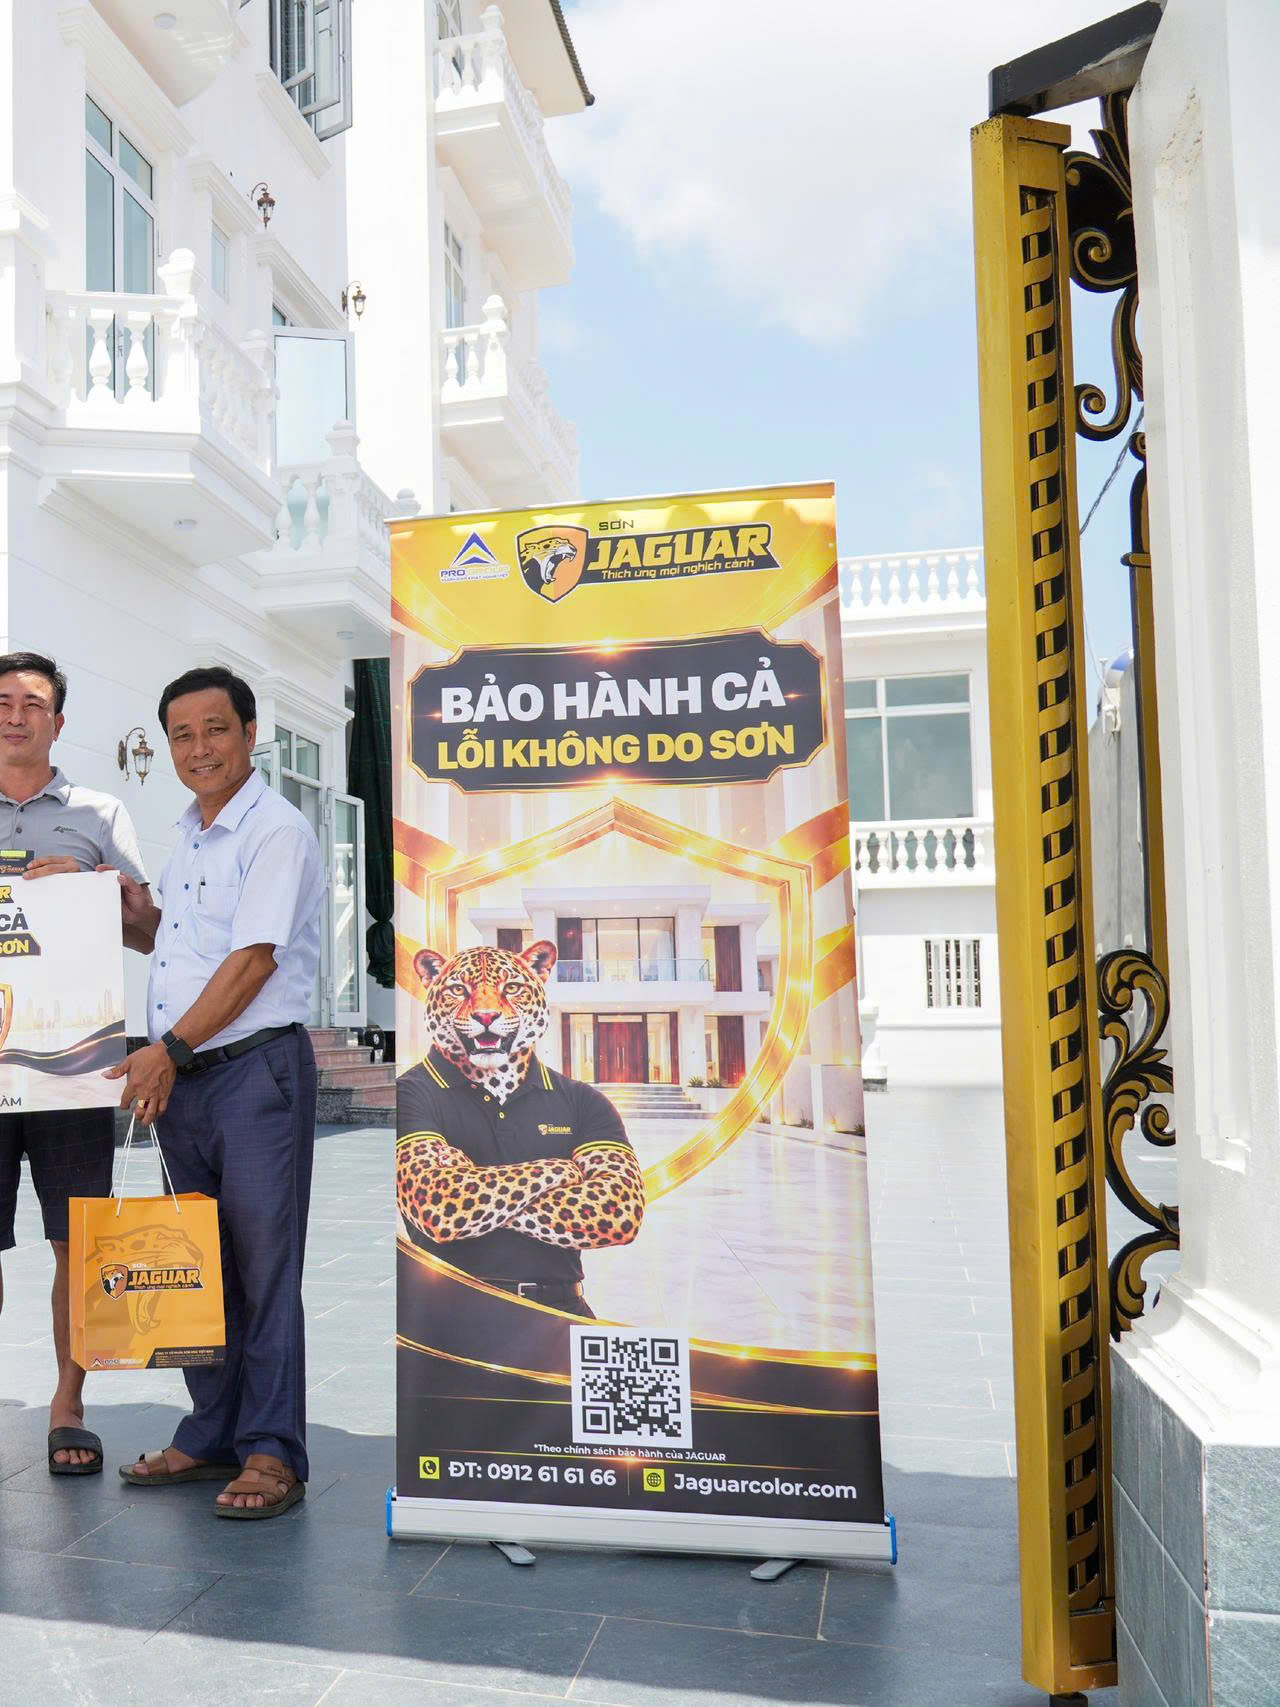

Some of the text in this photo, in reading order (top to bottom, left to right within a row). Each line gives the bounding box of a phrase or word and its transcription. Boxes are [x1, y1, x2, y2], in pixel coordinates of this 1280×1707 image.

[599, 519, 634, 530] SƠN
[587, 527, 769, 570] JAGUAR
[441, 569, 466, 577] PRO
[441, 657, 786, 723] BẢO HÀNH CẢ
[438, 721, 795, 770] LỖI KHÔNG DO SƠN
[128, 1269, 199, 1285] JAGUAR
[564, 1445, 590, 1455] chính
[593, 1447, 615, 1456] sách
[617, 1448, 636, 1457] bảo
[638, 1449, 663, 1459] hành
[666, 1451, 683, 1459] của
[685, 1452, 726, 1462] JAGUAR
[448, 1461, 616, 1486] ĐT: 0912 61 61 66
[674, 1473, 857, 1499] Jaguarcolor.com
